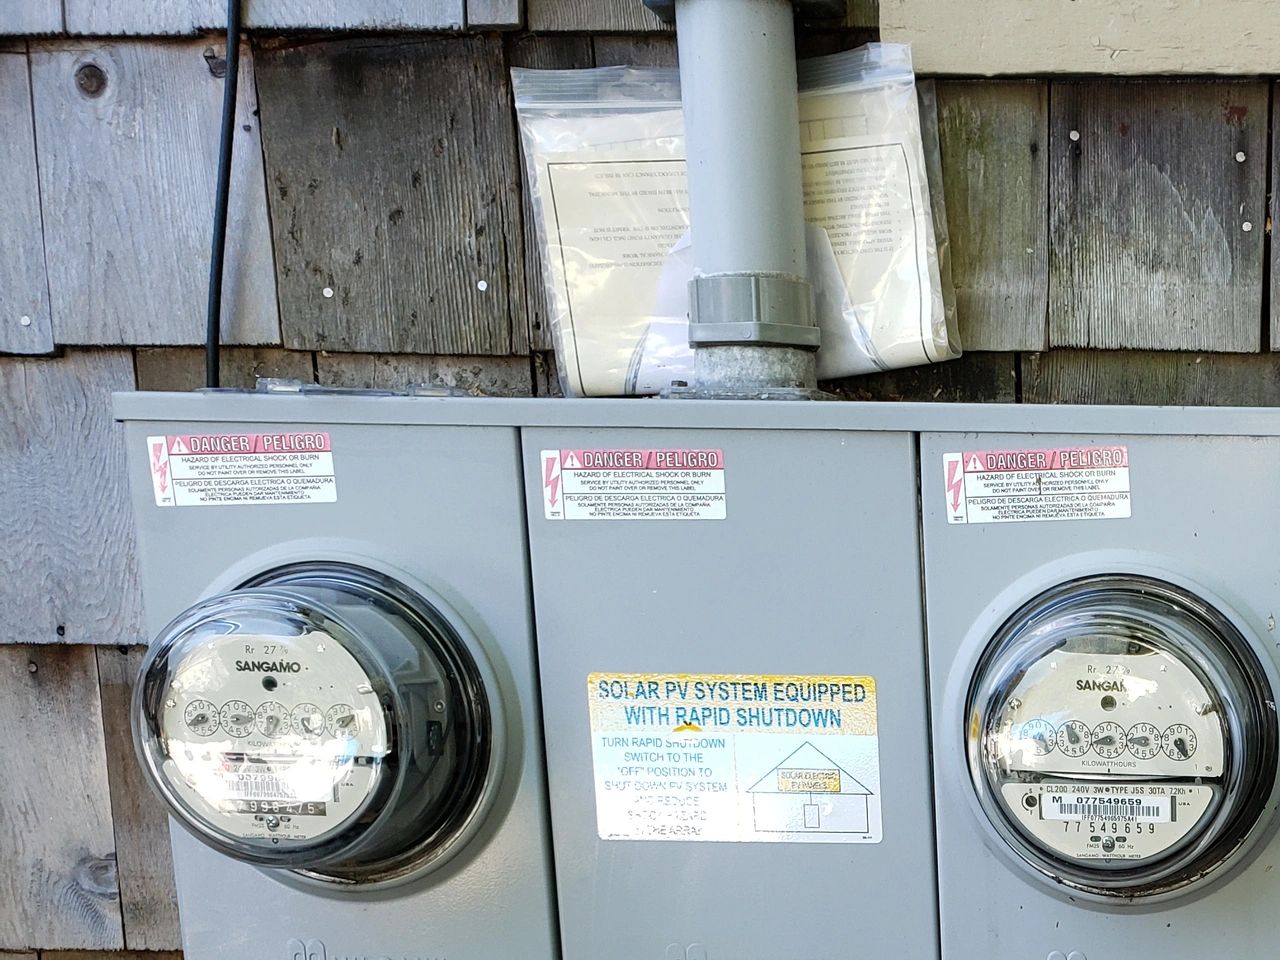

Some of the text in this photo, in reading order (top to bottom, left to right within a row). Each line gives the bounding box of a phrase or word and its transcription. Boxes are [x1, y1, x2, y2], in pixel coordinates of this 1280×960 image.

[190, 436, 250, 452] DANGER
[263, 433, 325, 451] PELIGRO
[583, 452, 642, 468] DANGER
[656, 452, 718, 468] PELIGRO
[986, 452, 1047, 470] DANGER
[1060, 449, 1123, 467] PELIGRO
[235, 660, 300, 673] SANGAMO
[599, 680, 866, 703] SOLAR PV SYSTEM EQUIPPED
[624, 706, 842, 728] WITH RAPID SHUTDOWN
[602, 737, 725, 748] TURN RAPID SHUTDOWN
[624, 752, 703, 763] SWITCH TO THE
[1082, 760, 1136, 768] KILOWATTHOURS
[647, 767, 695, 777] POSITION
[698, 768, 712, 777] TO
[1076, 797, 1142, 805] 077549659
